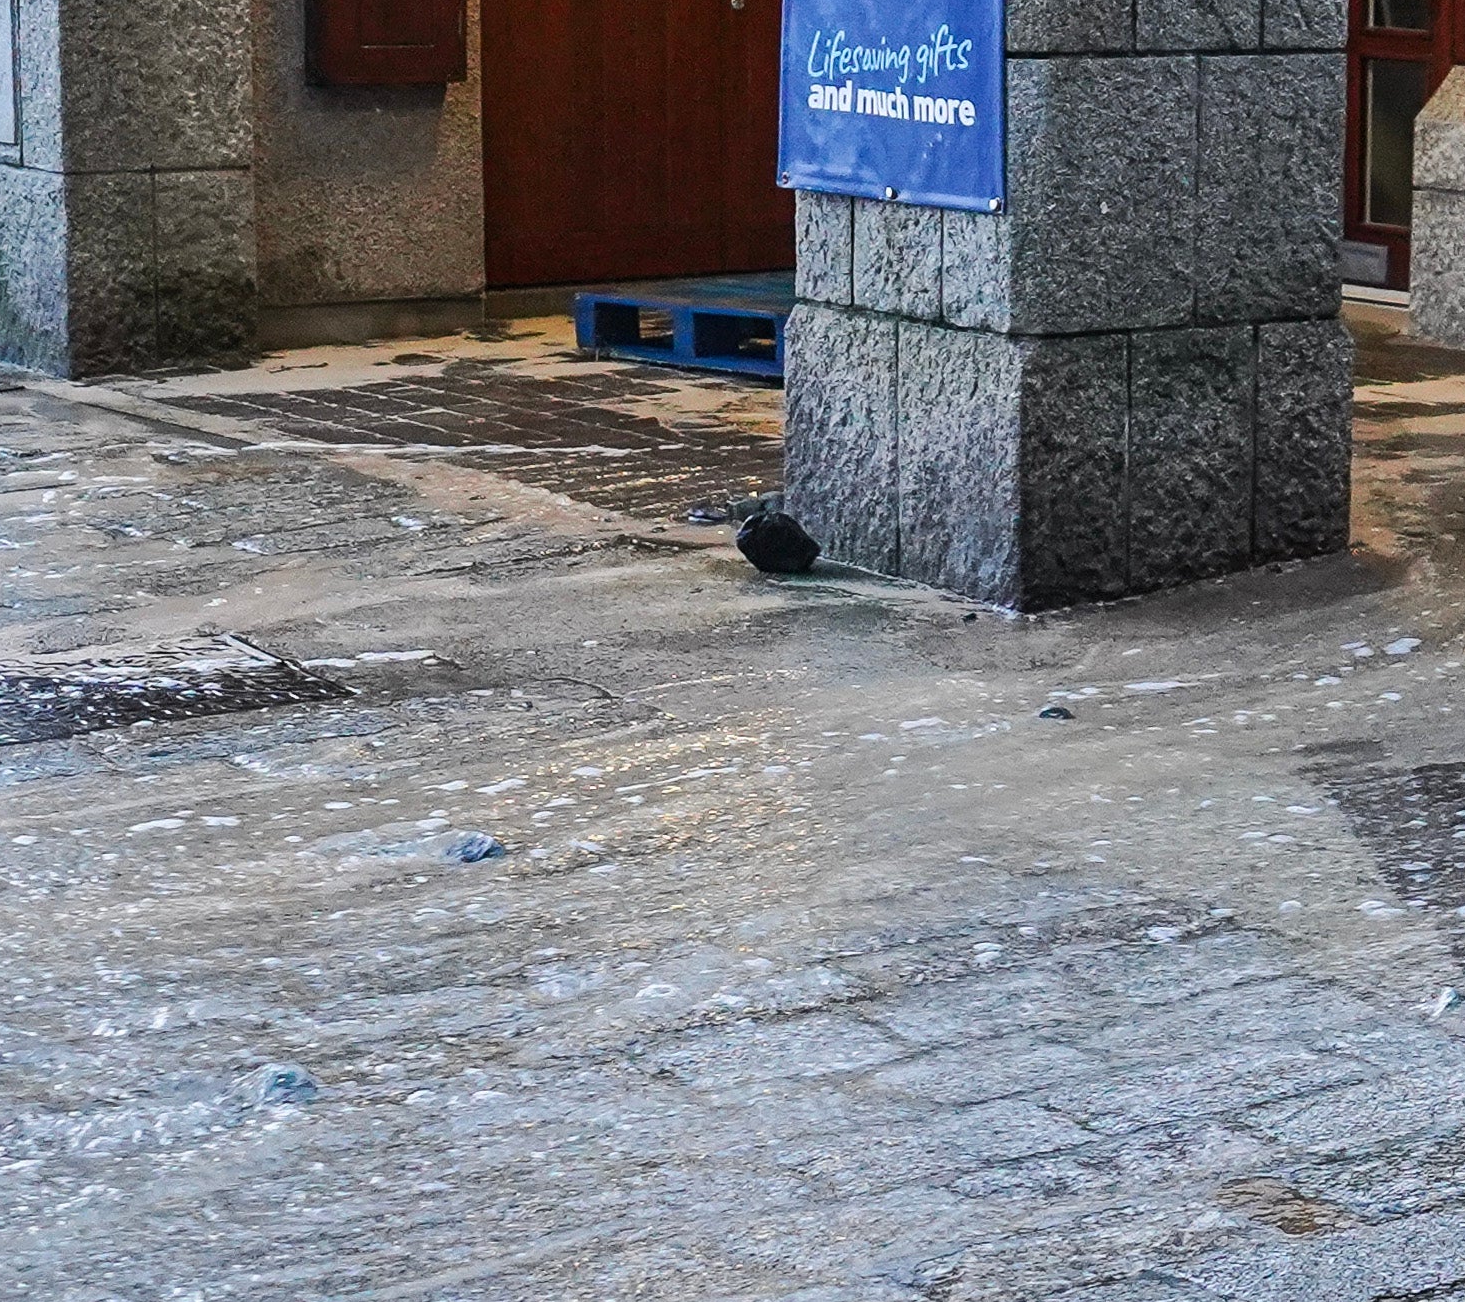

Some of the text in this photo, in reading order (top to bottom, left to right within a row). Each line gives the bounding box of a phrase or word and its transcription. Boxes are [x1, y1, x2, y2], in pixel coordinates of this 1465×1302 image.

[807, 24, 973, 84] Lifesaving gifts
[807, 79, 976, 127] and much more
